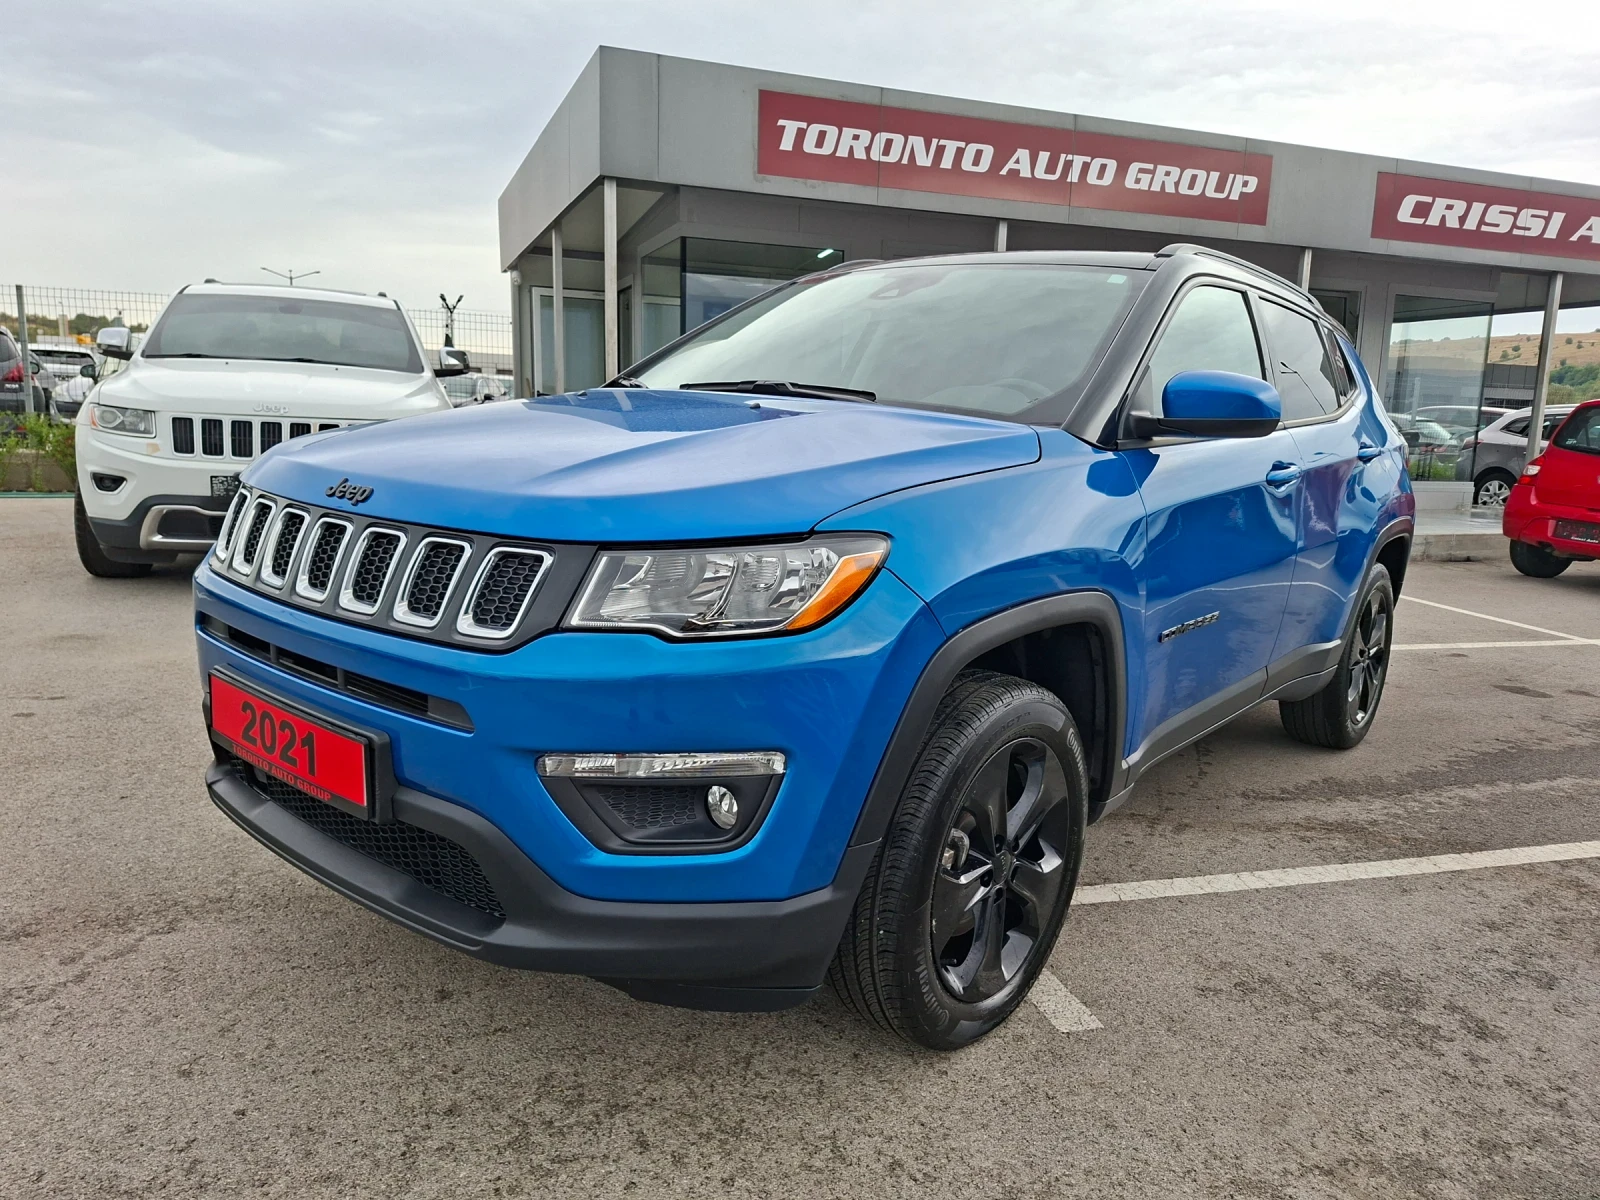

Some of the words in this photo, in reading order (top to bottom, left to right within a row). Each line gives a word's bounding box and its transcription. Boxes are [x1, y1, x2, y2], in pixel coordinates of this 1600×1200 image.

[777, 119, 994, 172] TORONTO
[998, 148, 1118, 187] AUTO
[1124, 162, 1258, 200] GROUP
[1396, 194, 1567, 239] CRISSI
[252, 401, 289, 415] Jeep
[325, 477, 374, 506] Jeep
[241, 701, 316, 777] 2021
[232, 744, 269, 771] TORONTO
[271, 766, 295, 785] AUTO
[297, 779, 332, 801] GROUP
